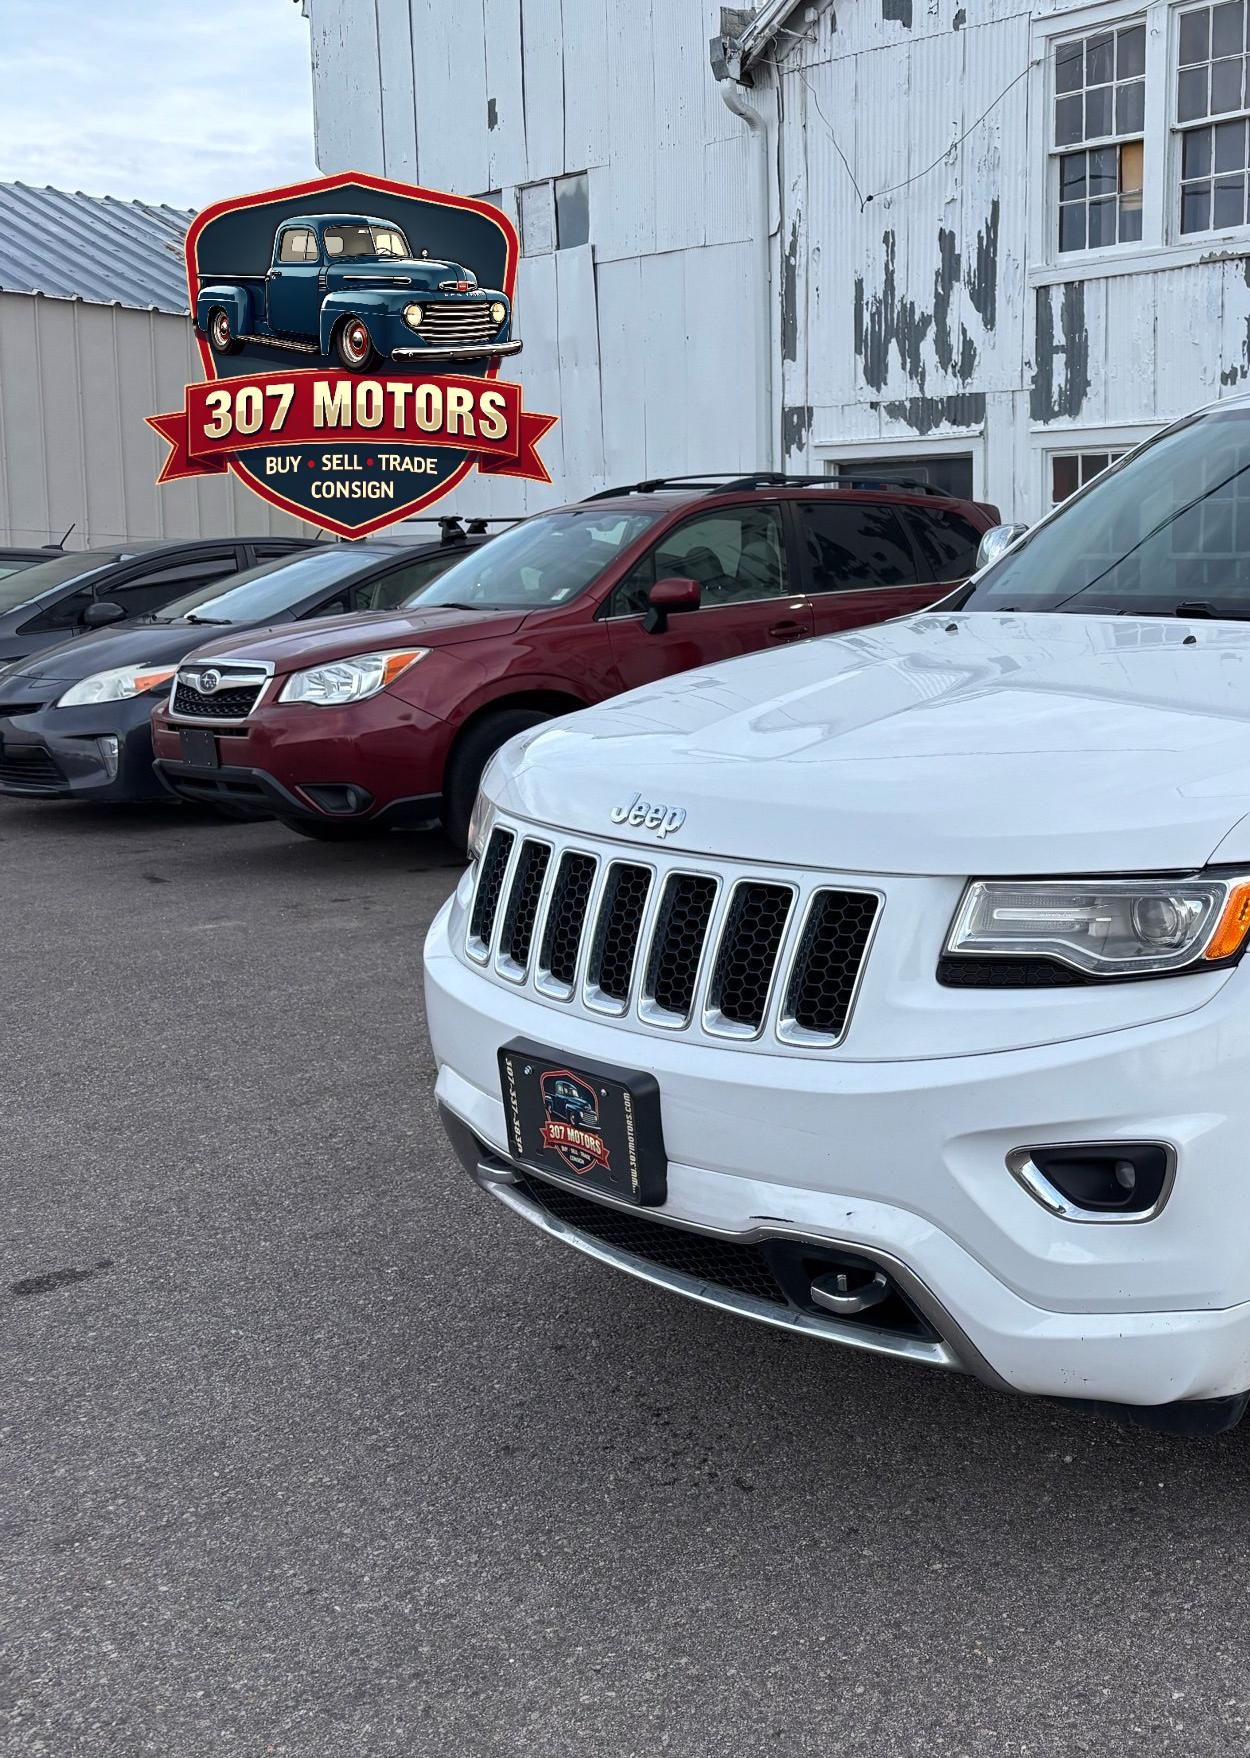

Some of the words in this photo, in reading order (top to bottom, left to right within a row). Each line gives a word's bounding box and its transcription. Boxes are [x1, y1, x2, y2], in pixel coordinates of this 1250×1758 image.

[609, 792, 687, 840] Jeep
[549, 1124, 565, 1140] 307
[566, 1127, 602, 1155] MOTORS
